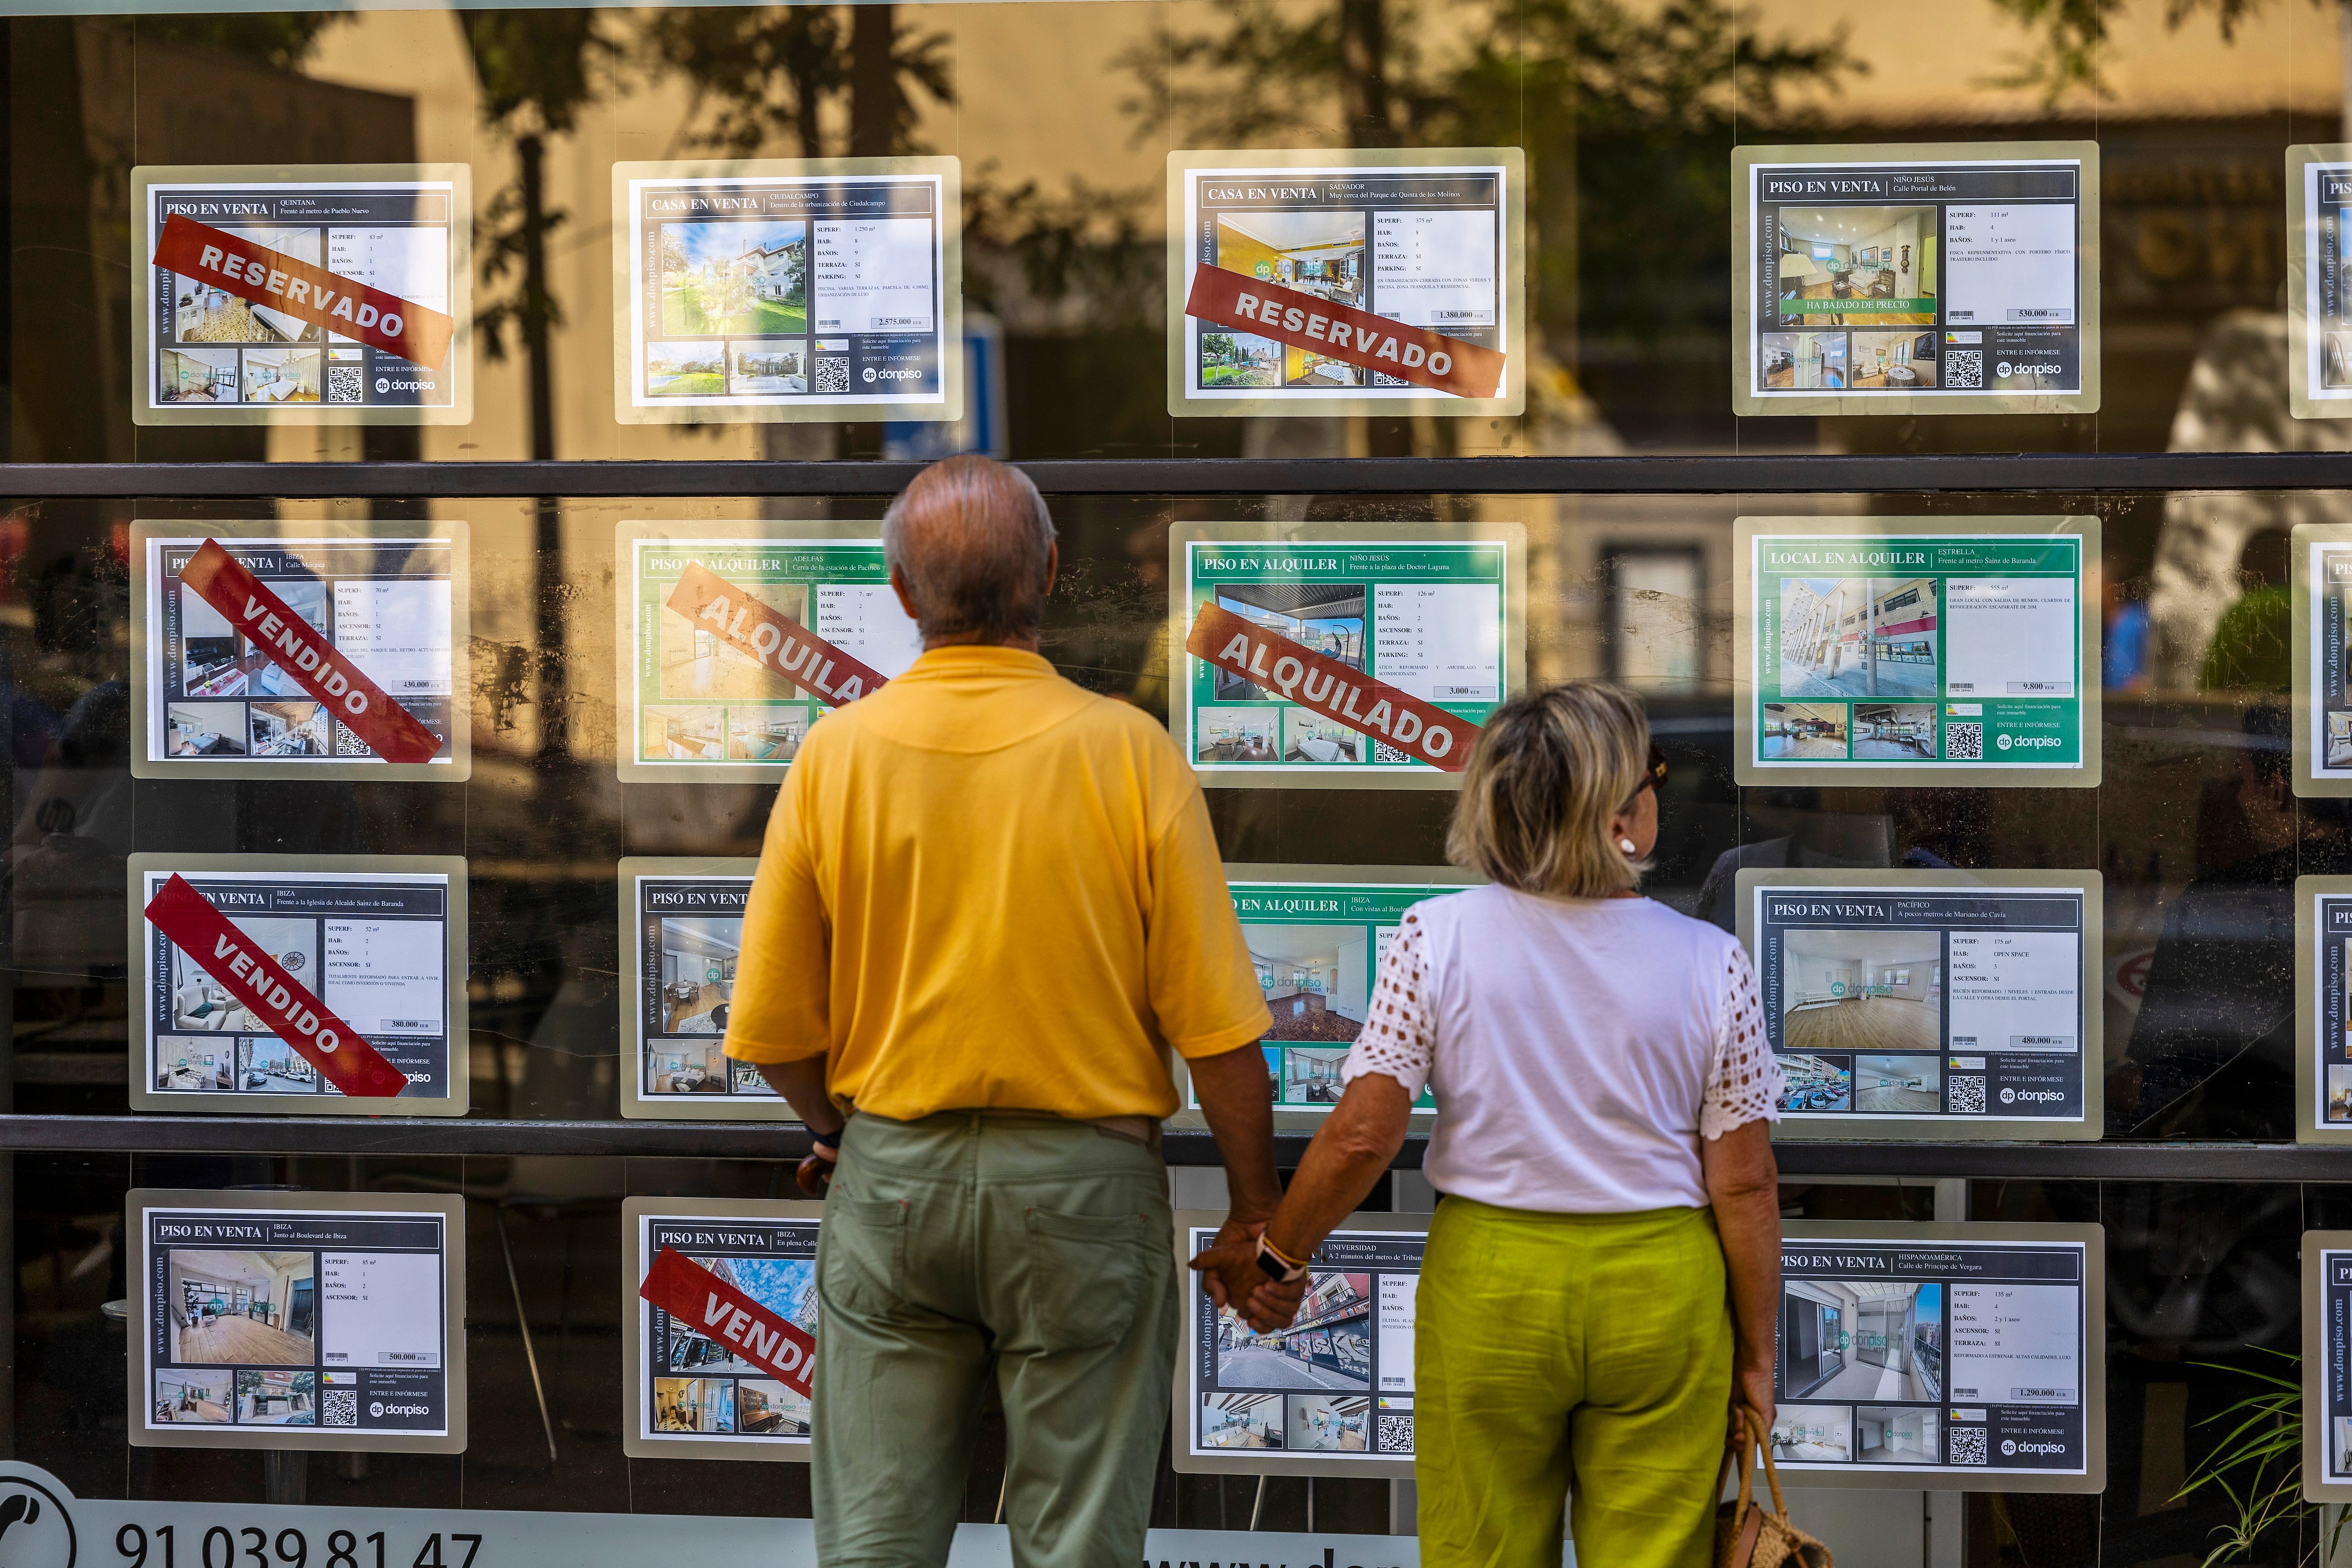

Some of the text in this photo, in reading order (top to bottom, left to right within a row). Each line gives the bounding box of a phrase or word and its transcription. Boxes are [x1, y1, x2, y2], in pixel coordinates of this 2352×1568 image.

[1209, 188, 1317, 199] CASA EN VENTA
[1770, 181, 1880, 193] PISO EN VENTA
[166, 204, 269, 214] PISO EN VENTA
[652, 198, 759, 210] CASA EN VENTA
[1763, 215, 1775, 318] www.donpiso.com
[646, 230, 657, 329] www.donpiso.com
[199, 244, 403, 337] RESERVADO
[1235, 292, 1452, 376] RESERVADO
[878, 368, 922, 382] donpiso
[2014, 362, 2062, 377] donpiso
[651, 558, 682, 570] PISO
[708, 559, 781, 572] ALQUILER
[1204, 559, 1337, 572] PISO EN ALQUILER
[1771, 552, 1925, 566] LOCAL EN ALQUILER
[242, 594, 369, 715] VENDIDO
[699, 595, 879, 703] ALQUILA
[1218, 632, 1454, 758] ALQUILADO
[2014, 735, 2061, 749] donpiso
[219, 893, 265, 904] VENTA
[652, 893, 748, 904] PISO EN VENT
[1241, 899, 1339, 913] EN ALQUILER
[1774, 904, 1884, 916] PISO EN VENTA
[646, 925, 659, 1025] www.donpiso.com
[214, 933, 340, 1053] VENDIDO
[2018, 1090, 2064, 1104] donpiso
[160, 1226, 262, 1237] PISO EN VENTA
[660, 1233, 765, 1245] PISO EN VENTA
[1812, 1256, 1832, 1267] EN
[1836, 1257, 1885, 1268] VENTA
[155, 1257, 167, 1355] www.donpiso.com
[704, 1291, 816, 1388] VENDI
[386, 1403, 429, 1417] donpiso
[116, 1523, 483, 1568] 91 039 81 47
